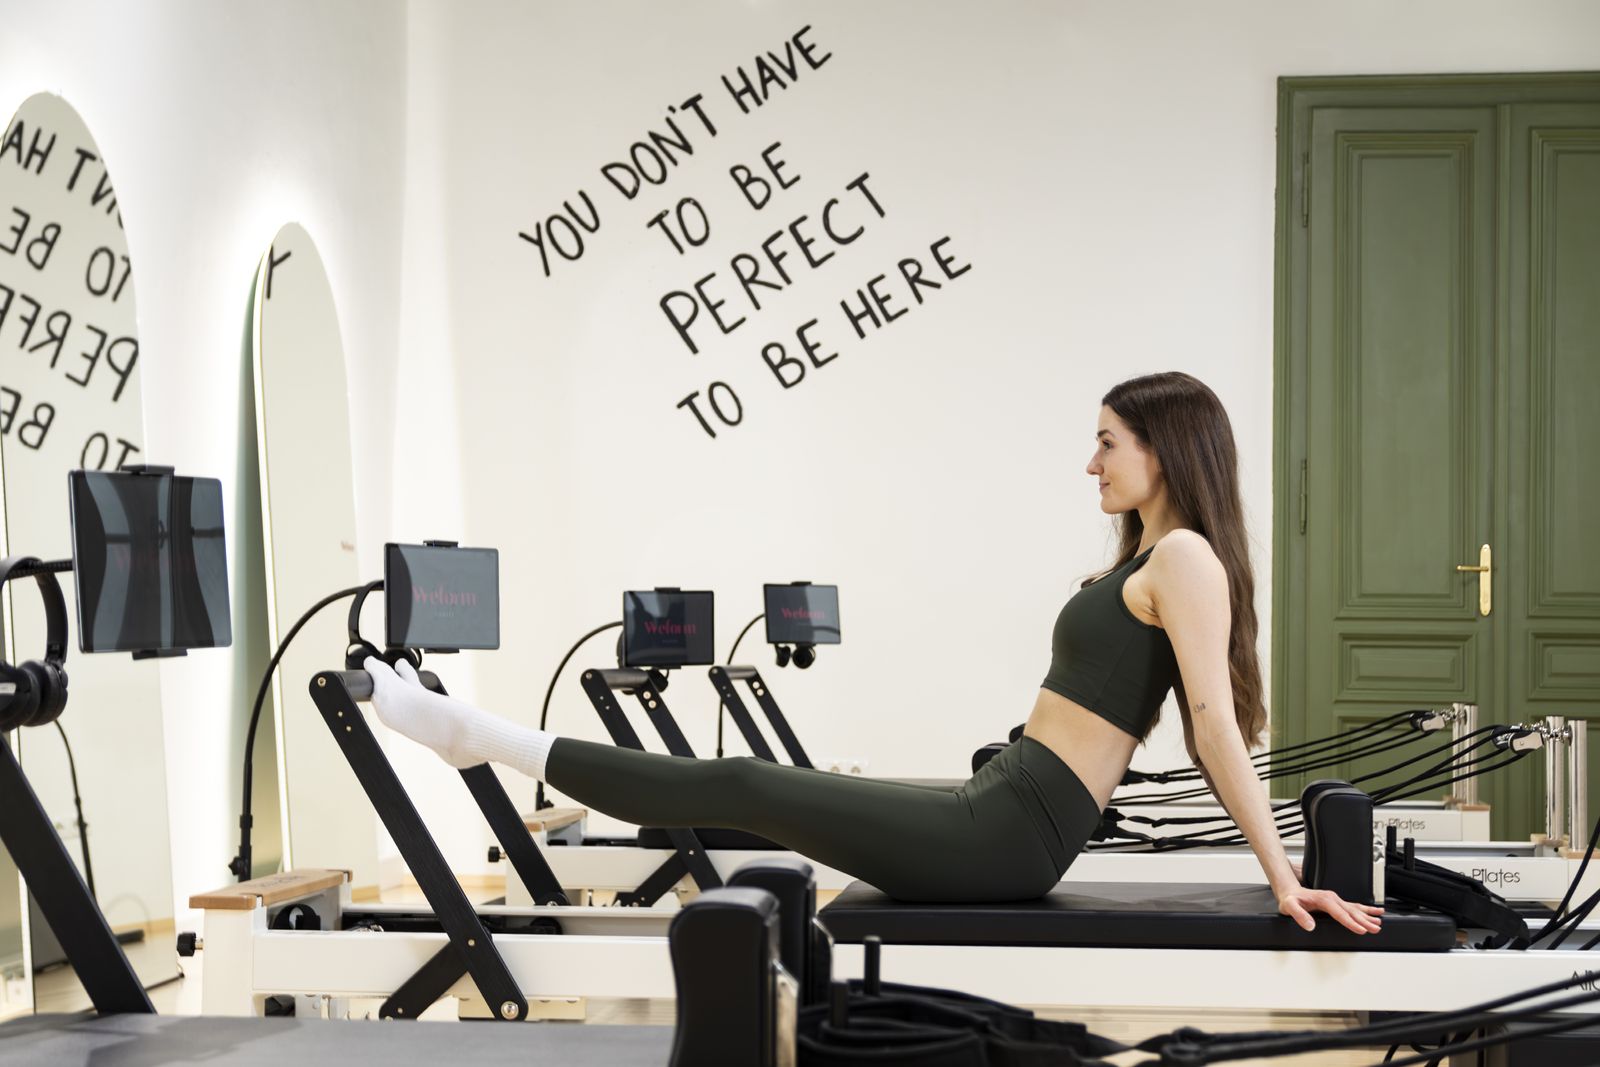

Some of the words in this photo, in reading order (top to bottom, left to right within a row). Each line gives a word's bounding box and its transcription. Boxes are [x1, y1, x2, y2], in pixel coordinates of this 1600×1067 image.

[519, 190, 600, 277] YOU
[601, 93, 717, 200] DON'T
[721, 25, 833, 114] HAVE
[647, 197, 710, 255] TO
[730, 141, 801, 211] BE
[660, 172, 886, 355] PERFECT
[676, 381, 743, 439] TO
[761, 318, 839, 389] BE
[840, 236, 972, 340] HERE
